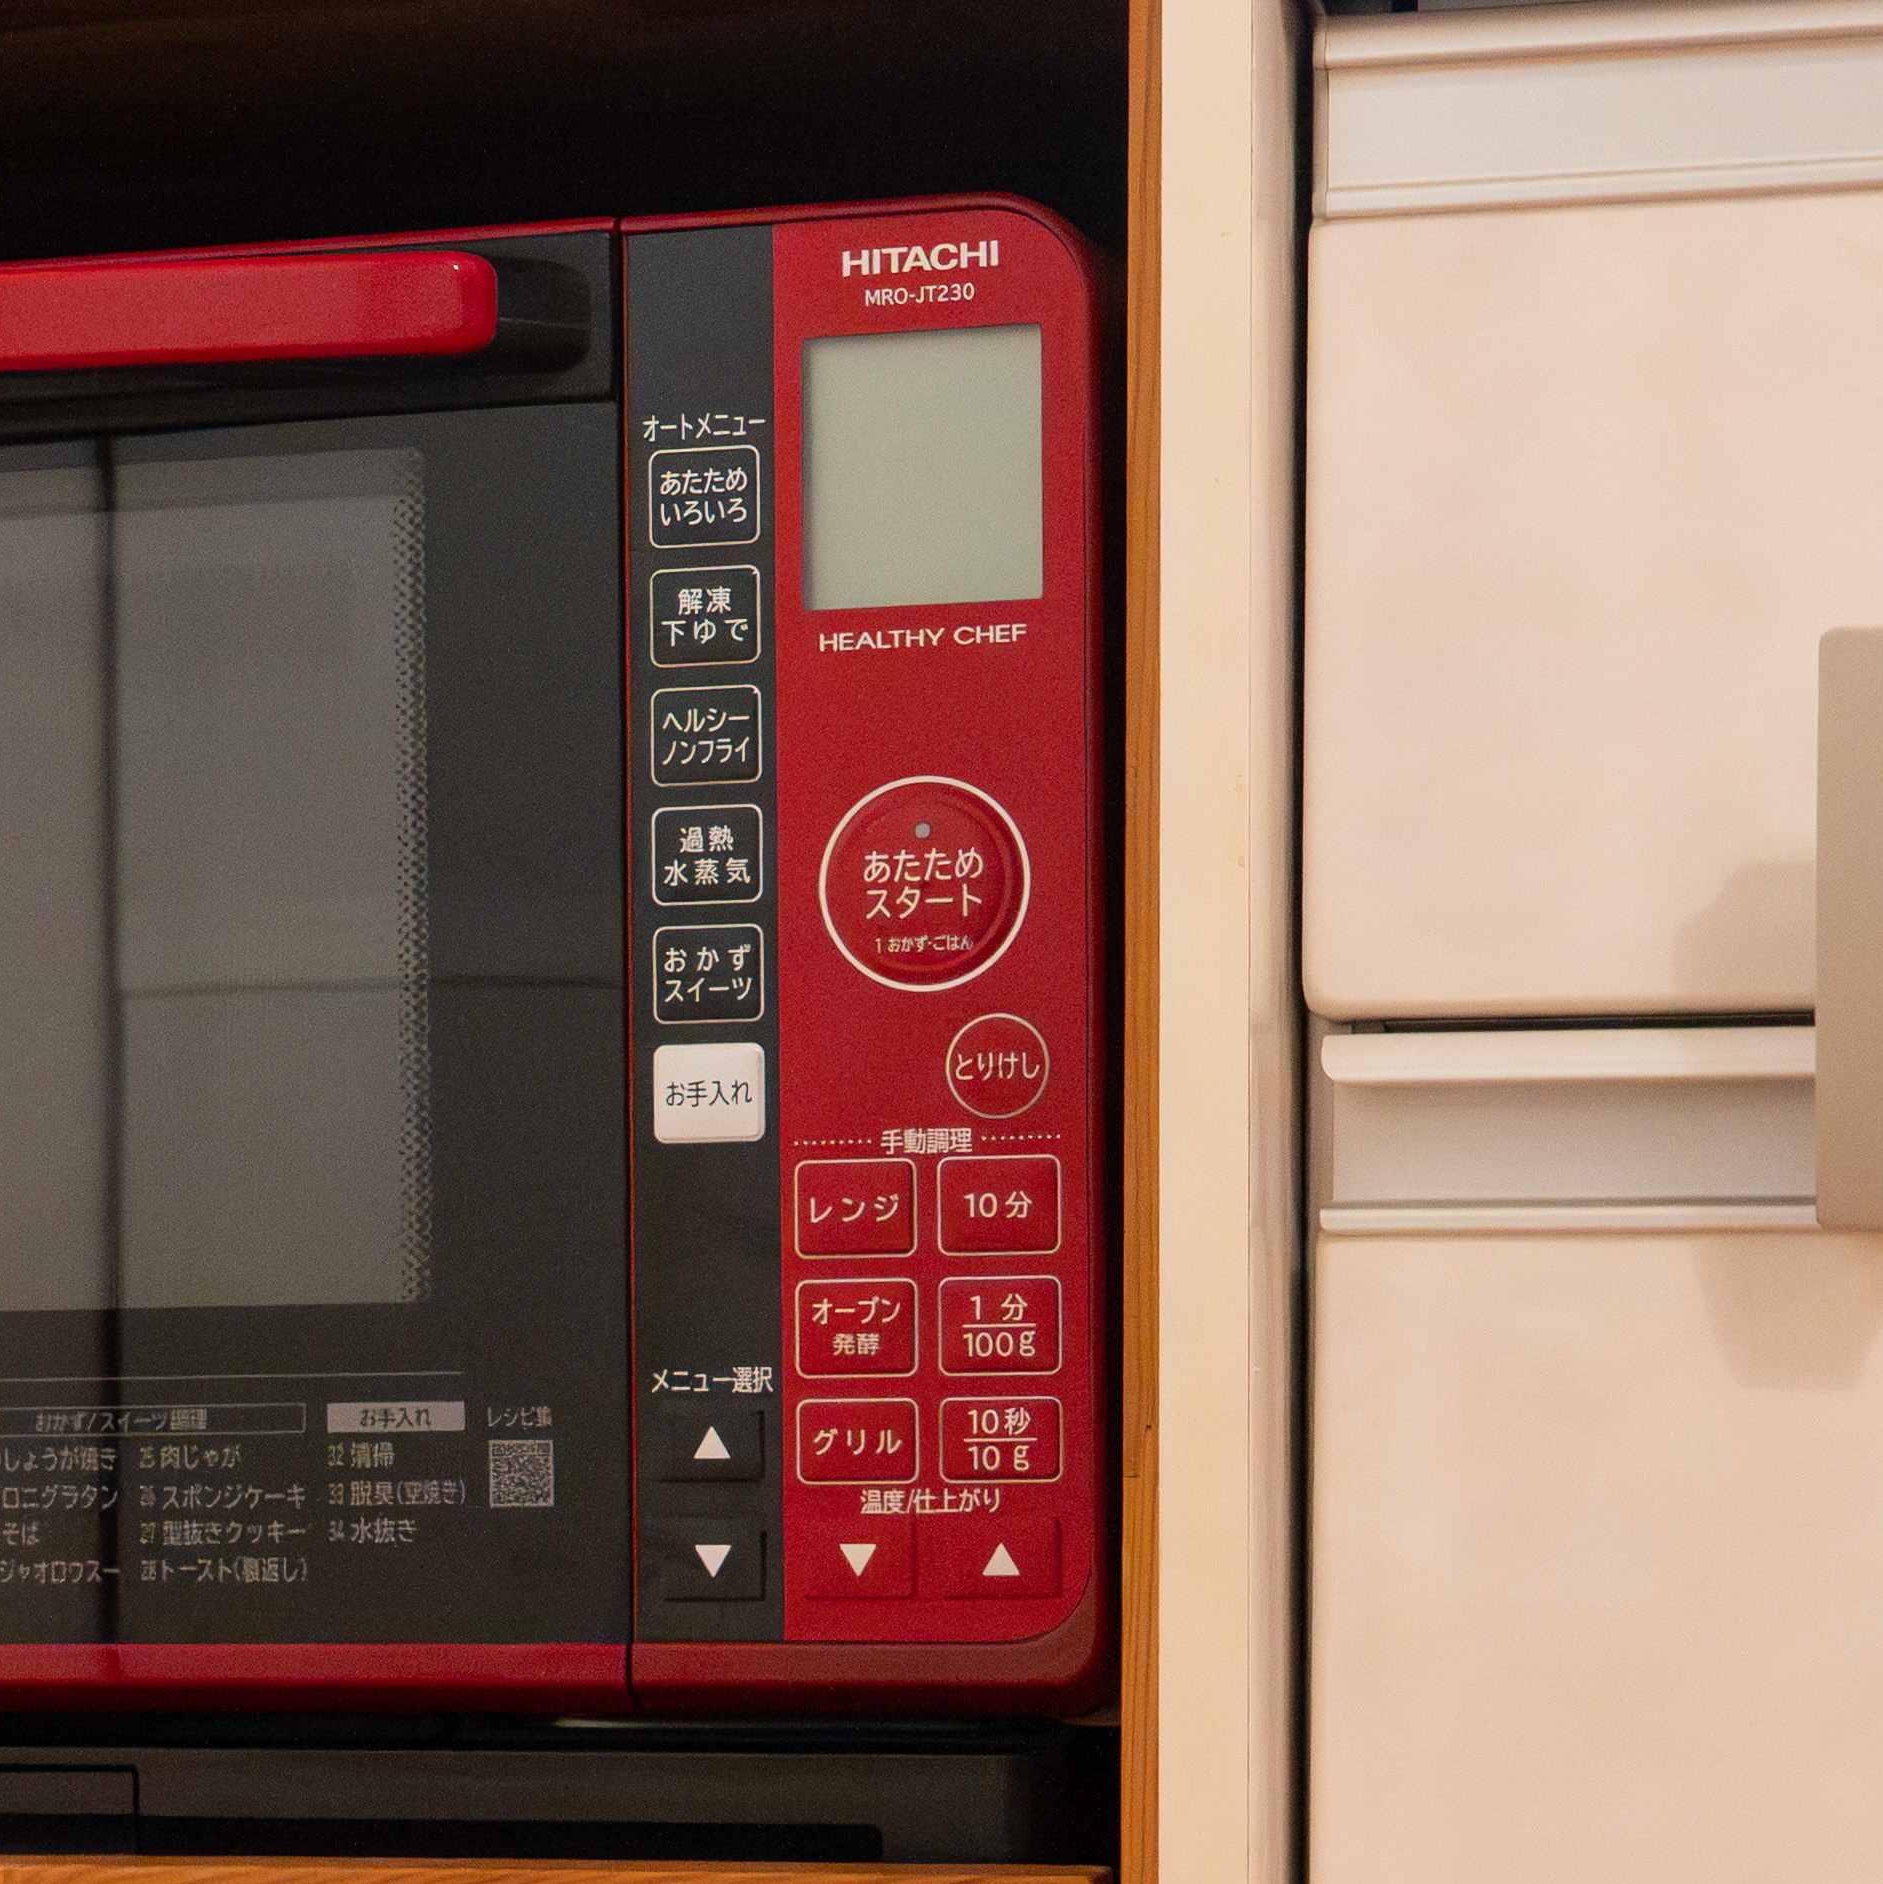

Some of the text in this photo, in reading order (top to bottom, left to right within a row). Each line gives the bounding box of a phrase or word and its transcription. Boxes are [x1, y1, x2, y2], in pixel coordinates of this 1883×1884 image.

[842, 240, 999, 277] HITACHI
[865, 283, 975, 307] MRO-JT230
[643, 414, 765, 441] オートメニュー
[660, 467, 748, 496] あたため
[660, 498, 748, 526] いろいろ
[677, 587, 732, 615] 解凍
[662, 617, 749, 647] 下ゆで
[819, 623, 1027, 652] HEALTHY CHEF
[662, 707, 750, 733] ヘルシー
[662, 736, 751, 766] ノンフライ
[679, 825, 734, 853] 過熱
[664, 858, 752, 886] 水蒸気
[863, 848, 984, 883] あたため
[866, 885, 983, 920] スタート
[664, 944, 752, 973] おかず
[664, 976, 753, 1003] スイーツ
[955, 1051, 1040, 1081] とりけし
[666, 1080, 753, 1107] お手入れ
[880, 1127, 974, 1154] 手動調理
[809, 1193, 899, 1223] レンジ
[812, 1297, 901, 1325] オープン
[833, 1333, 880, 1356] 発酵
[652, 1366, 773, 1393] メニュー選択
[359, 1407, 431, 1430] お手入れ
[813, 1429, 902, 1456] グリル
[861, 1489, 1001, 1515] 温度/仕上がり
